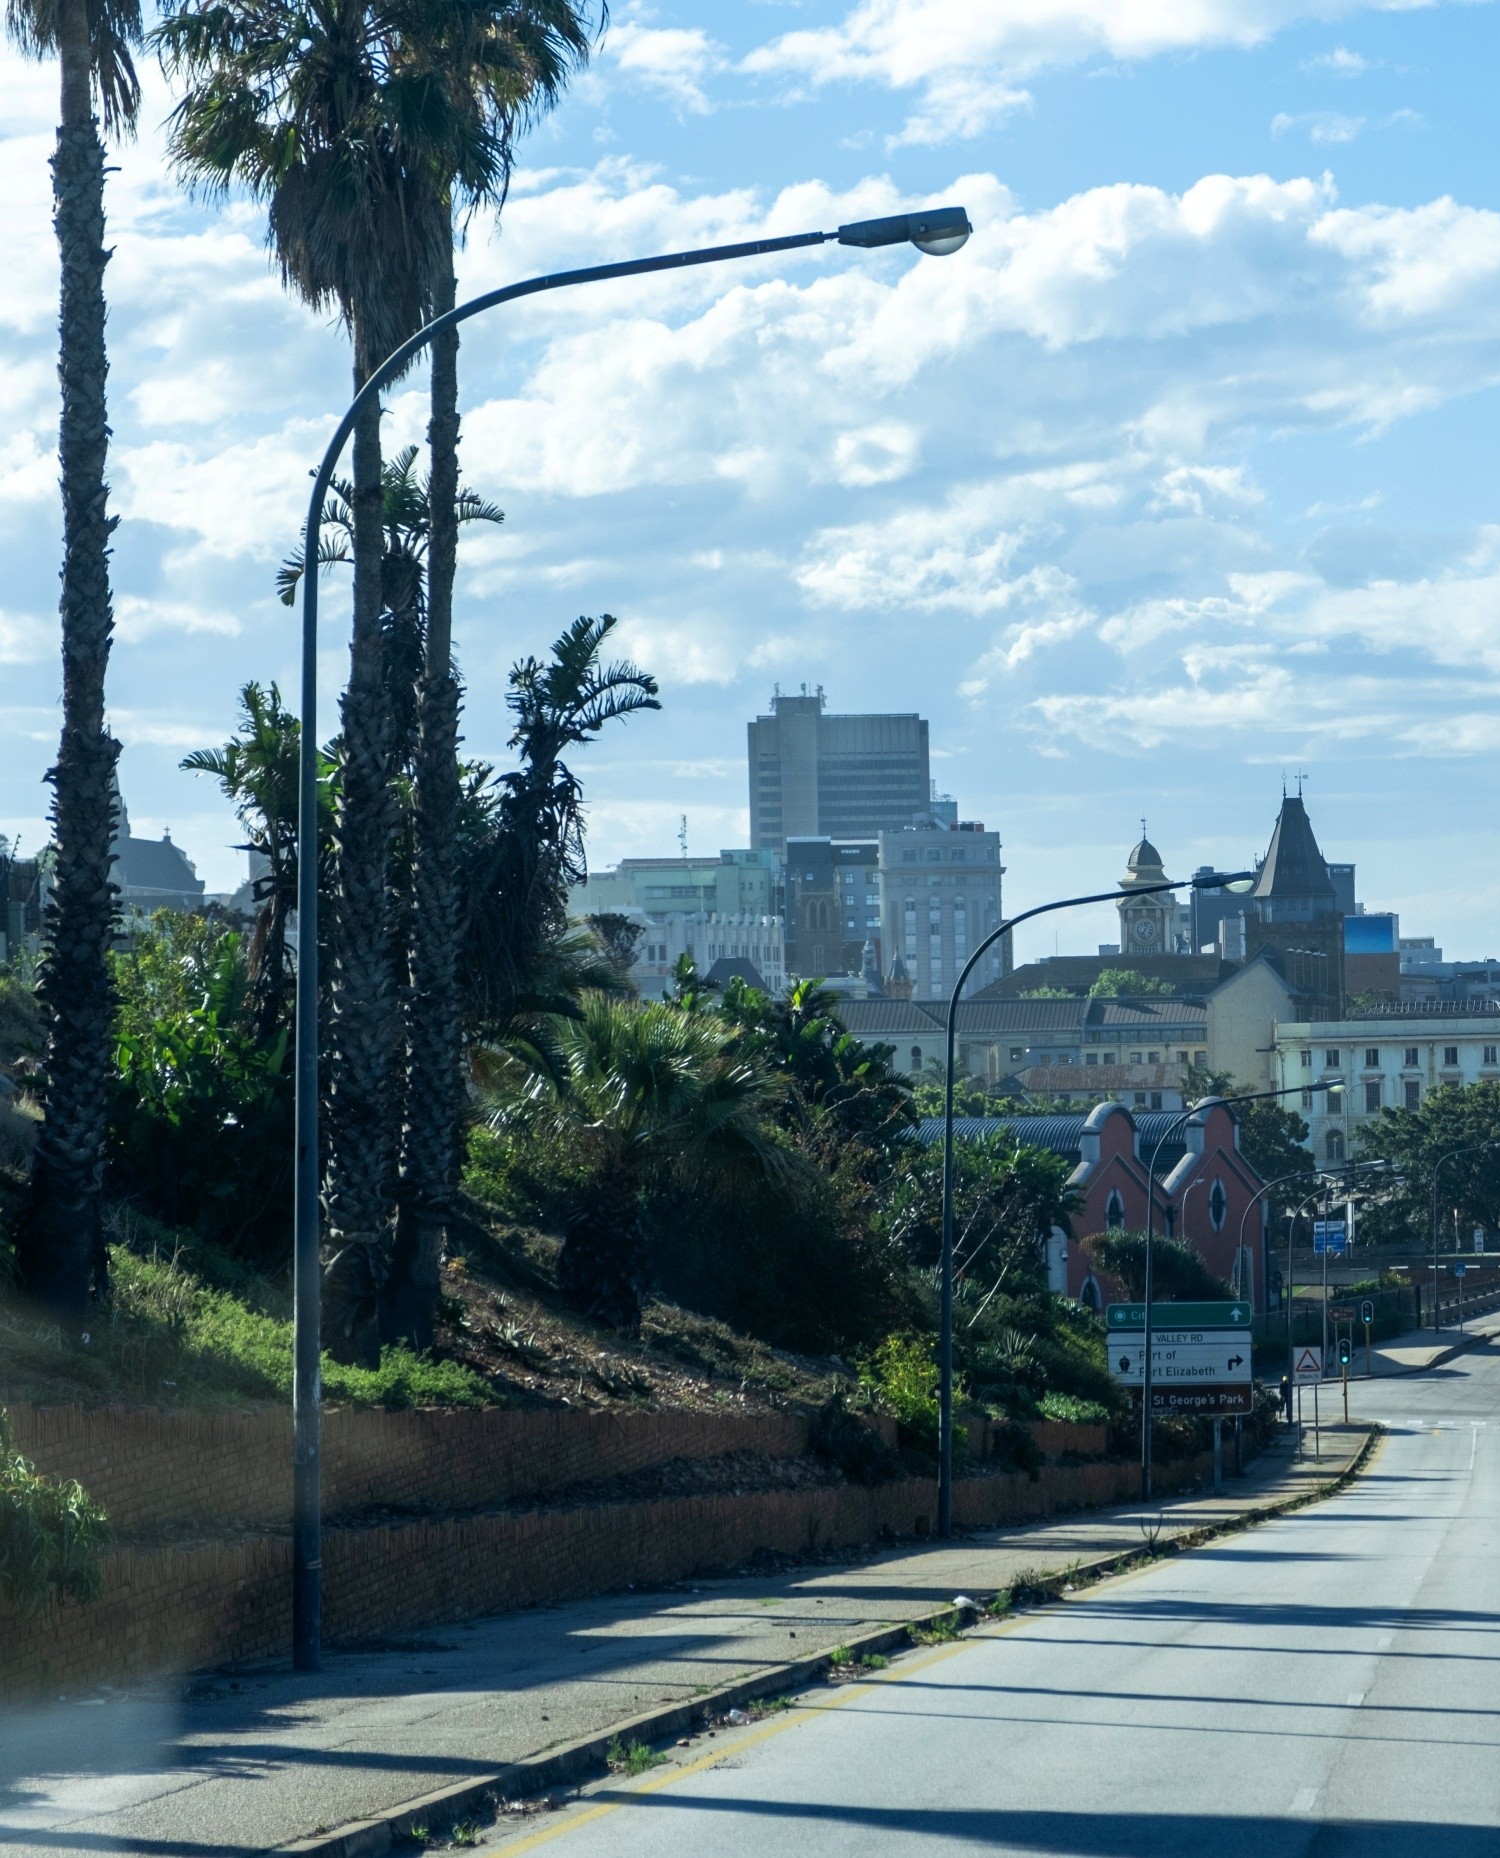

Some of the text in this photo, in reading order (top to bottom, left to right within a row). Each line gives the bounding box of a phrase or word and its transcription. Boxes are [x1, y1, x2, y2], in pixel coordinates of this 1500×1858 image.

[1131, 1311, 1146, 1320] Cit
[1155, 1334, 1204, 1343] VALLEY RD
[1139, 1350, 1177, 1361] Prt of
[1139, 1366, 1216, 1377] Prt Elizabeth
[1153, 1393, 1245, 1407] St George's Park
